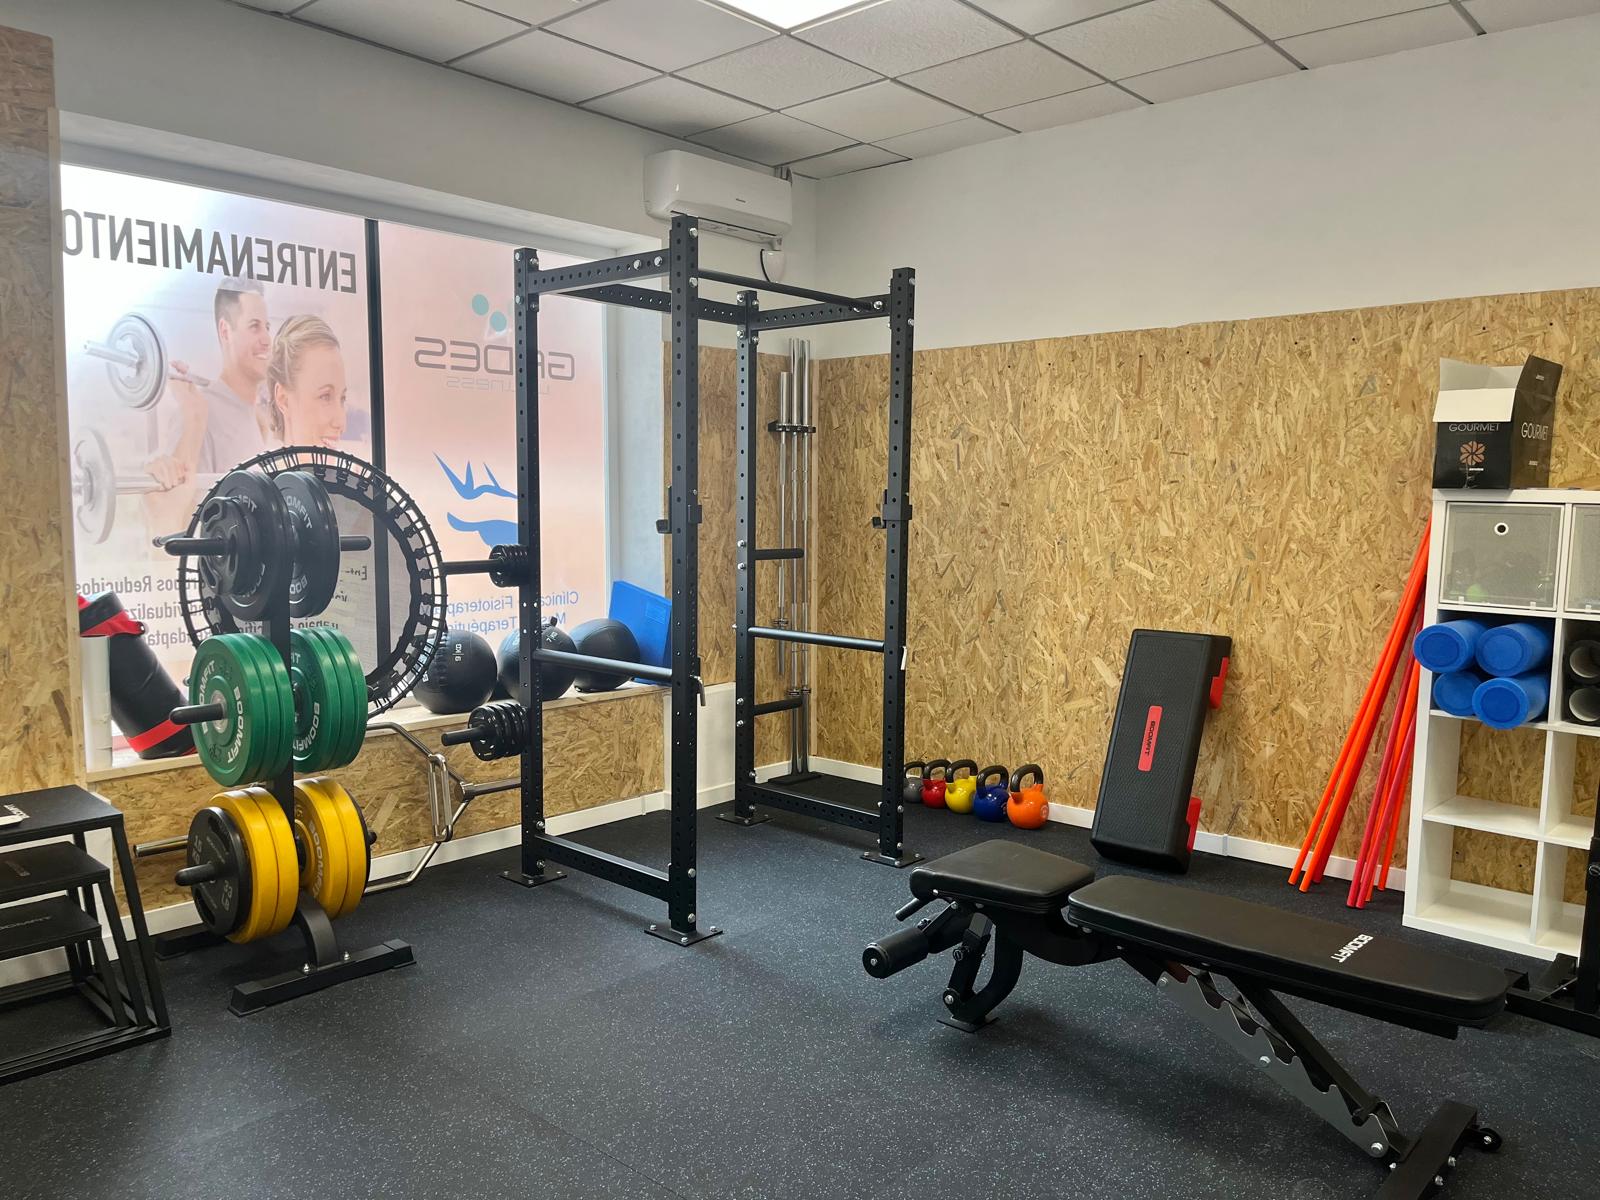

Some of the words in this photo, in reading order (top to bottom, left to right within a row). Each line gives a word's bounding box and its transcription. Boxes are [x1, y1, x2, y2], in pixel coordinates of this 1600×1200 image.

[1448, 423, 1500, 432] GOURMET
[198, 660, 215, 735] BOMFIT
[227, 686, 245, 764] BOOMFIT
[1330, 933, 1374, 963] BOOMFIT
